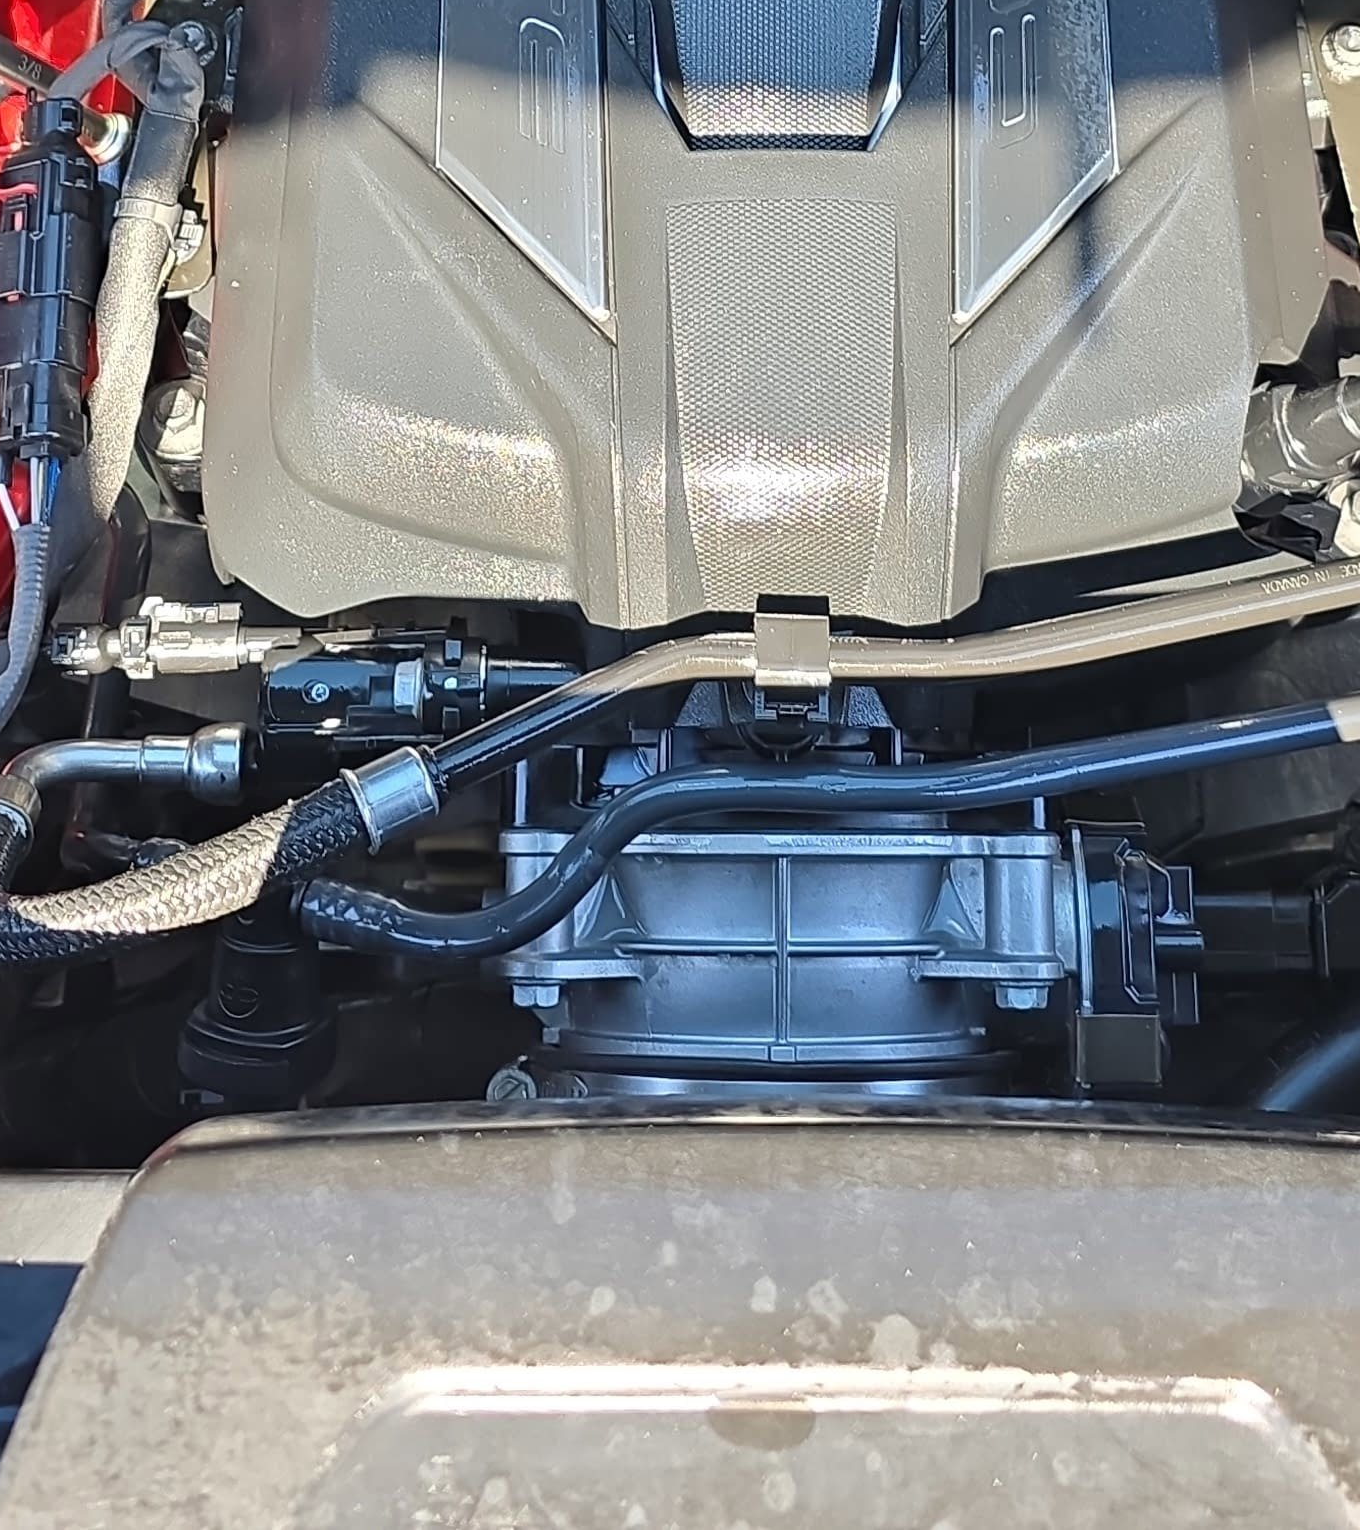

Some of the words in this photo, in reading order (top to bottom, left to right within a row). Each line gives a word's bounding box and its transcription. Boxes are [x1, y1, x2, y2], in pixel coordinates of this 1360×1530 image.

[17, 53, 43, 80] 3/8
[1261, 575, 1310, 595] CANADA
[1314, 568, 1331, 584] IN
